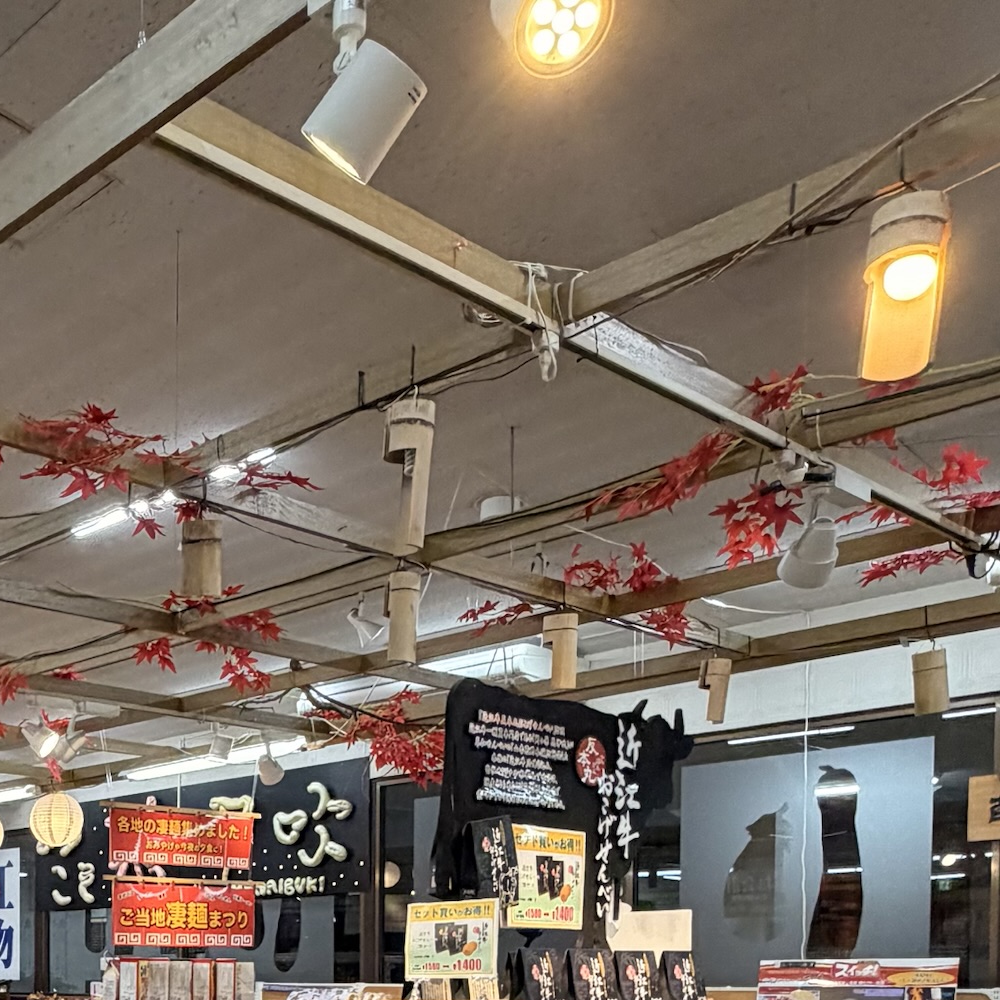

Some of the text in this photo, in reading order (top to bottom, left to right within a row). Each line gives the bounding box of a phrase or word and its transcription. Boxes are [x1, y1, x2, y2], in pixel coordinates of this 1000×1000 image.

[615, 718, 642, 859] 近江牛
[119, 901, 249, 929] ご当地凄麺まつり
